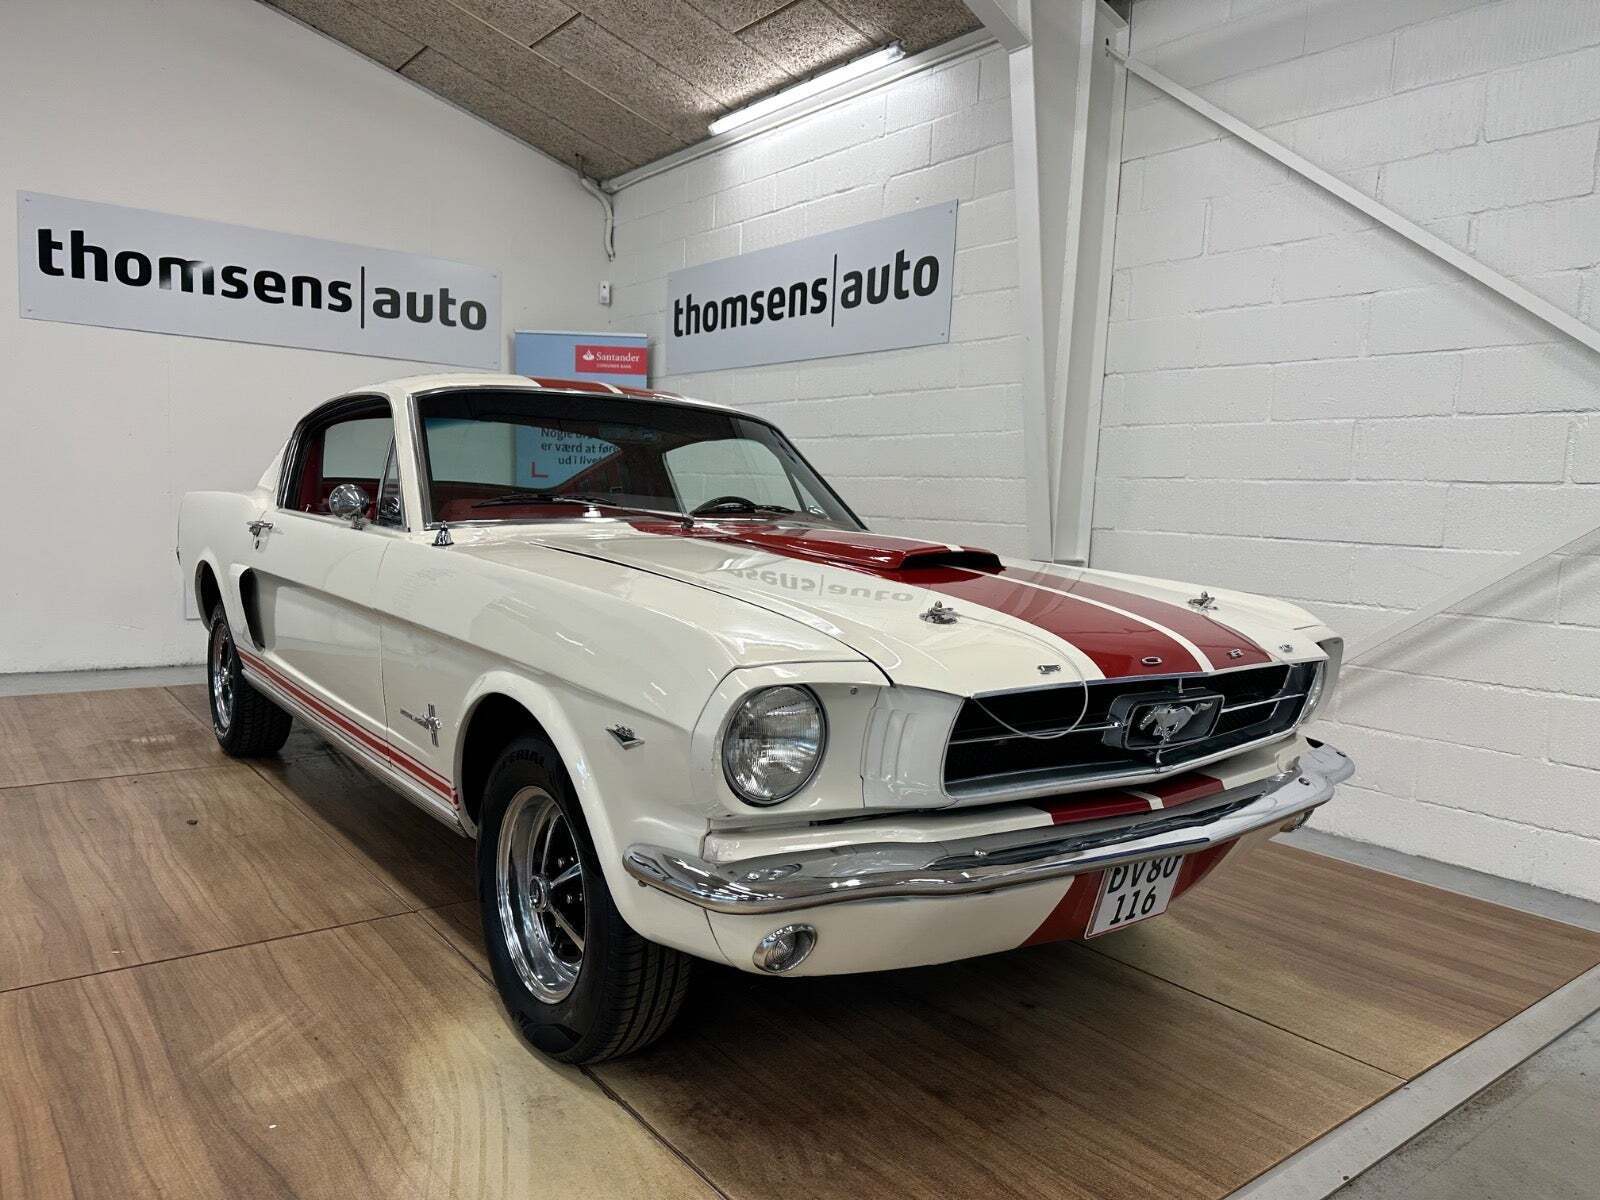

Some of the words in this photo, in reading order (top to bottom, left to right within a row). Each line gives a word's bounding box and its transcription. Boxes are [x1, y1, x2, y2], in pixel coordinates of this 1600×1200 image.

[37, 228, 352, 312] thomsens
[372, 286, 487, 331] auto
[673, 277, 828, 338] thomsens
[841, 248, 939, 309] auto
[596, 351, 640, 363] Santander
[541, 443, 551, 452] er
[555, 442, 583, 453] værd
[586, 445, 596, 454] at
[558, 455, 571, 465] ud
[1110, 886, 1156, 925] 116
